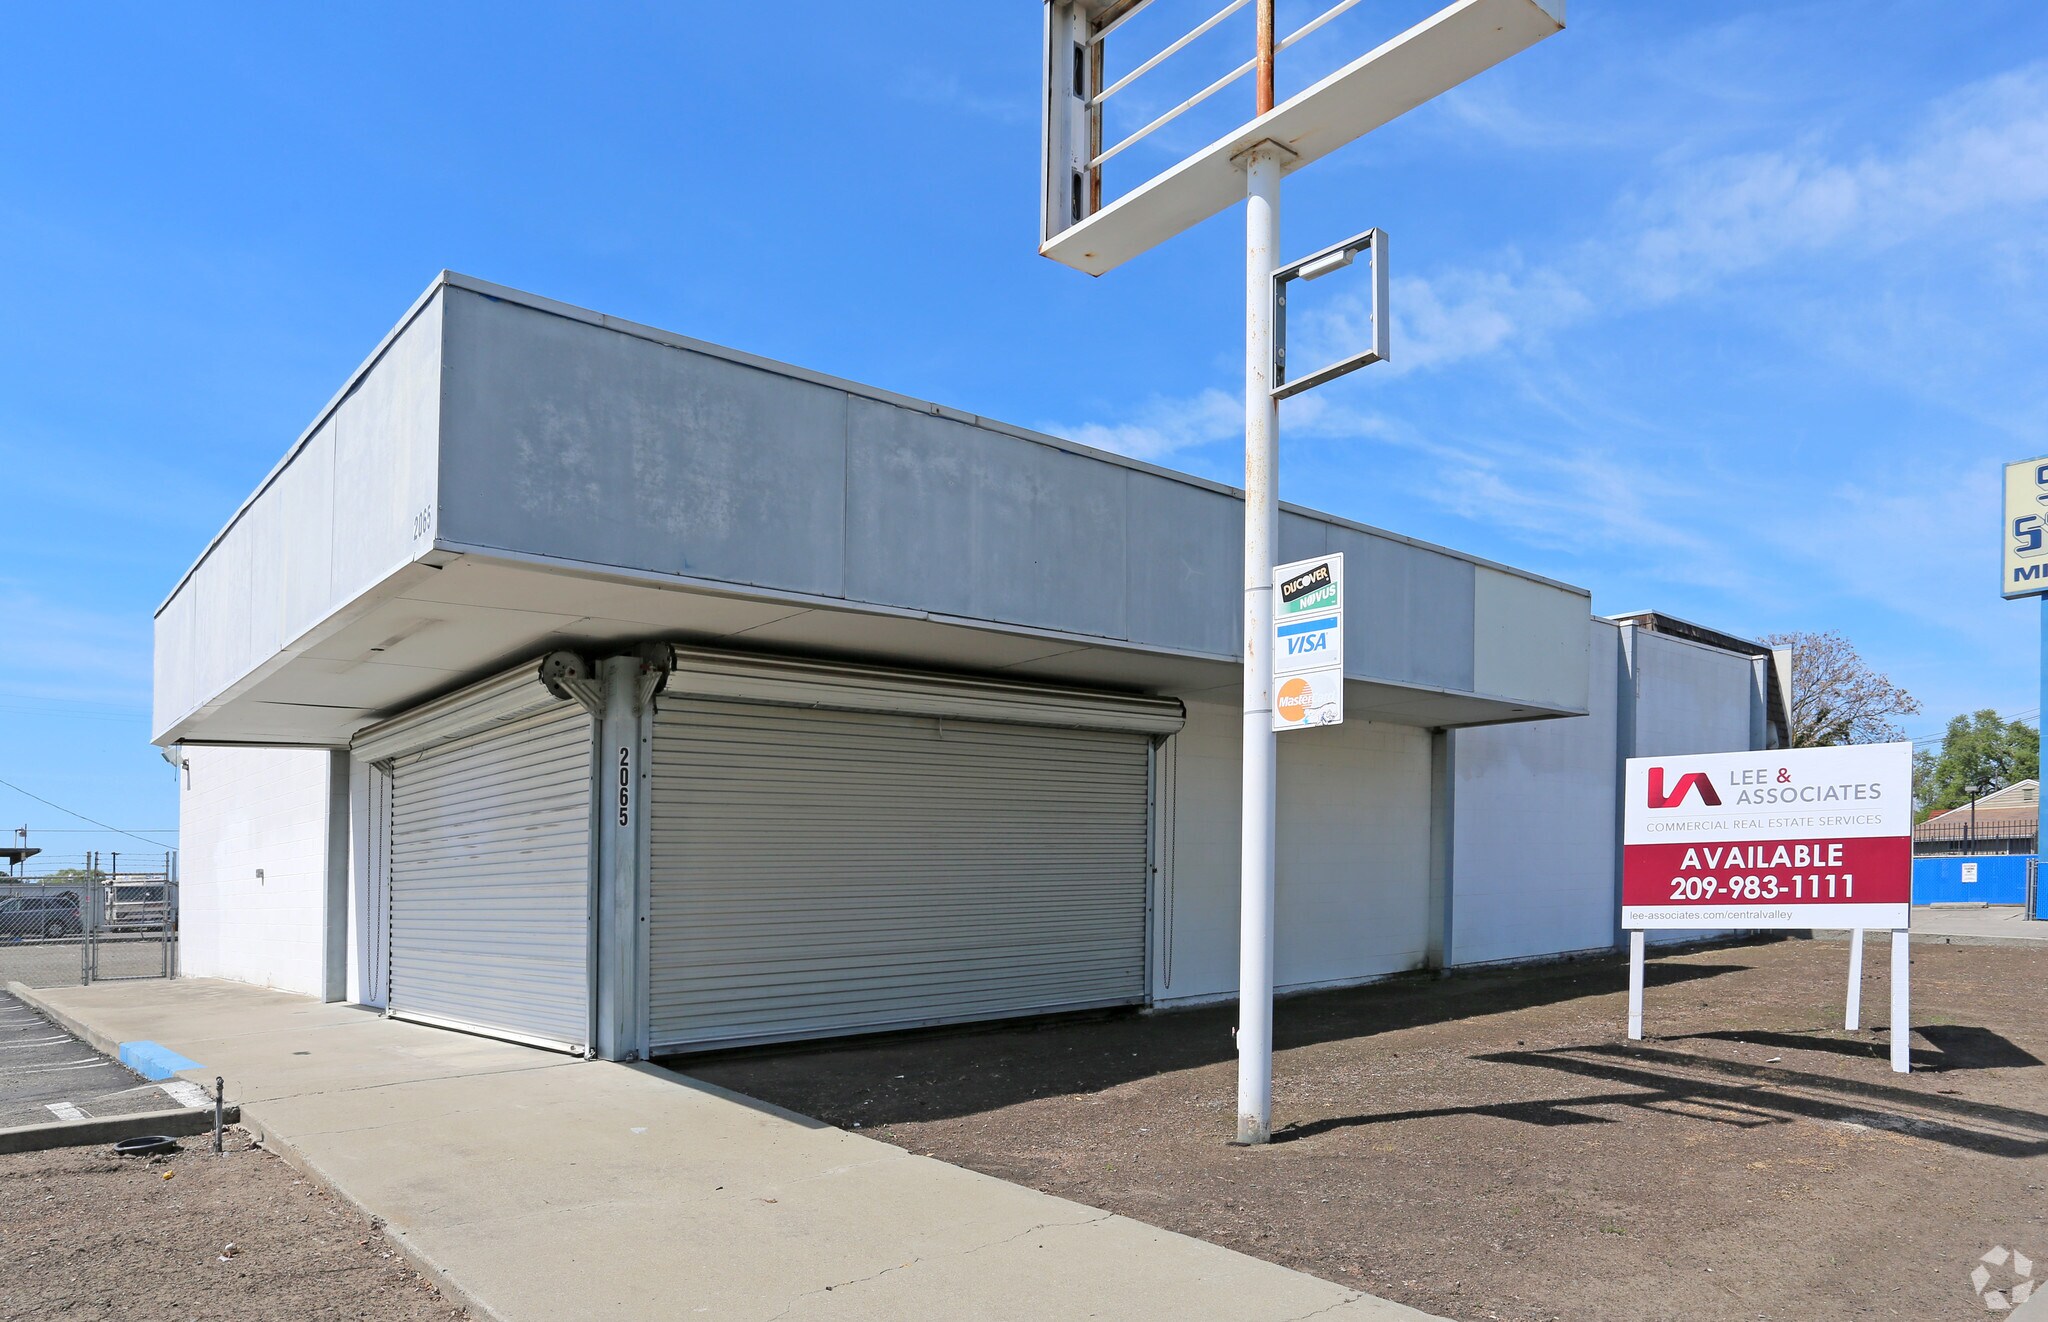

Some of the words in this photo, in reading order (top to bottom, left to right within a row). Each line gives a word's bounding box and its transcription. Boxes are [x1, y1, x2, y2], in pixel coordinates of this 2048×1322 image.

[1287, 632, 1327, 655] VISA
[619, 747, 629, 826] 2065
[1730, 769, 1768, 786] LEE
[1776, 767, 1792, 784] &
[1736, 782, 1882, 806] ASSOCIATES
[1646, 820, 1729, 833] COMMERCIAL
[1733, 818, 1764, 829] REAL
[1768, 817, 1814, 828] ESTATE
[1818, 814, 1882, 827] SERVICES
[1679, 843, 1844, 871] AVAILABLE
[1669, 873, 1853, 901] 209-983-1111
[1629, 909, 1793, 921] lee-associates.com/centralvalley
